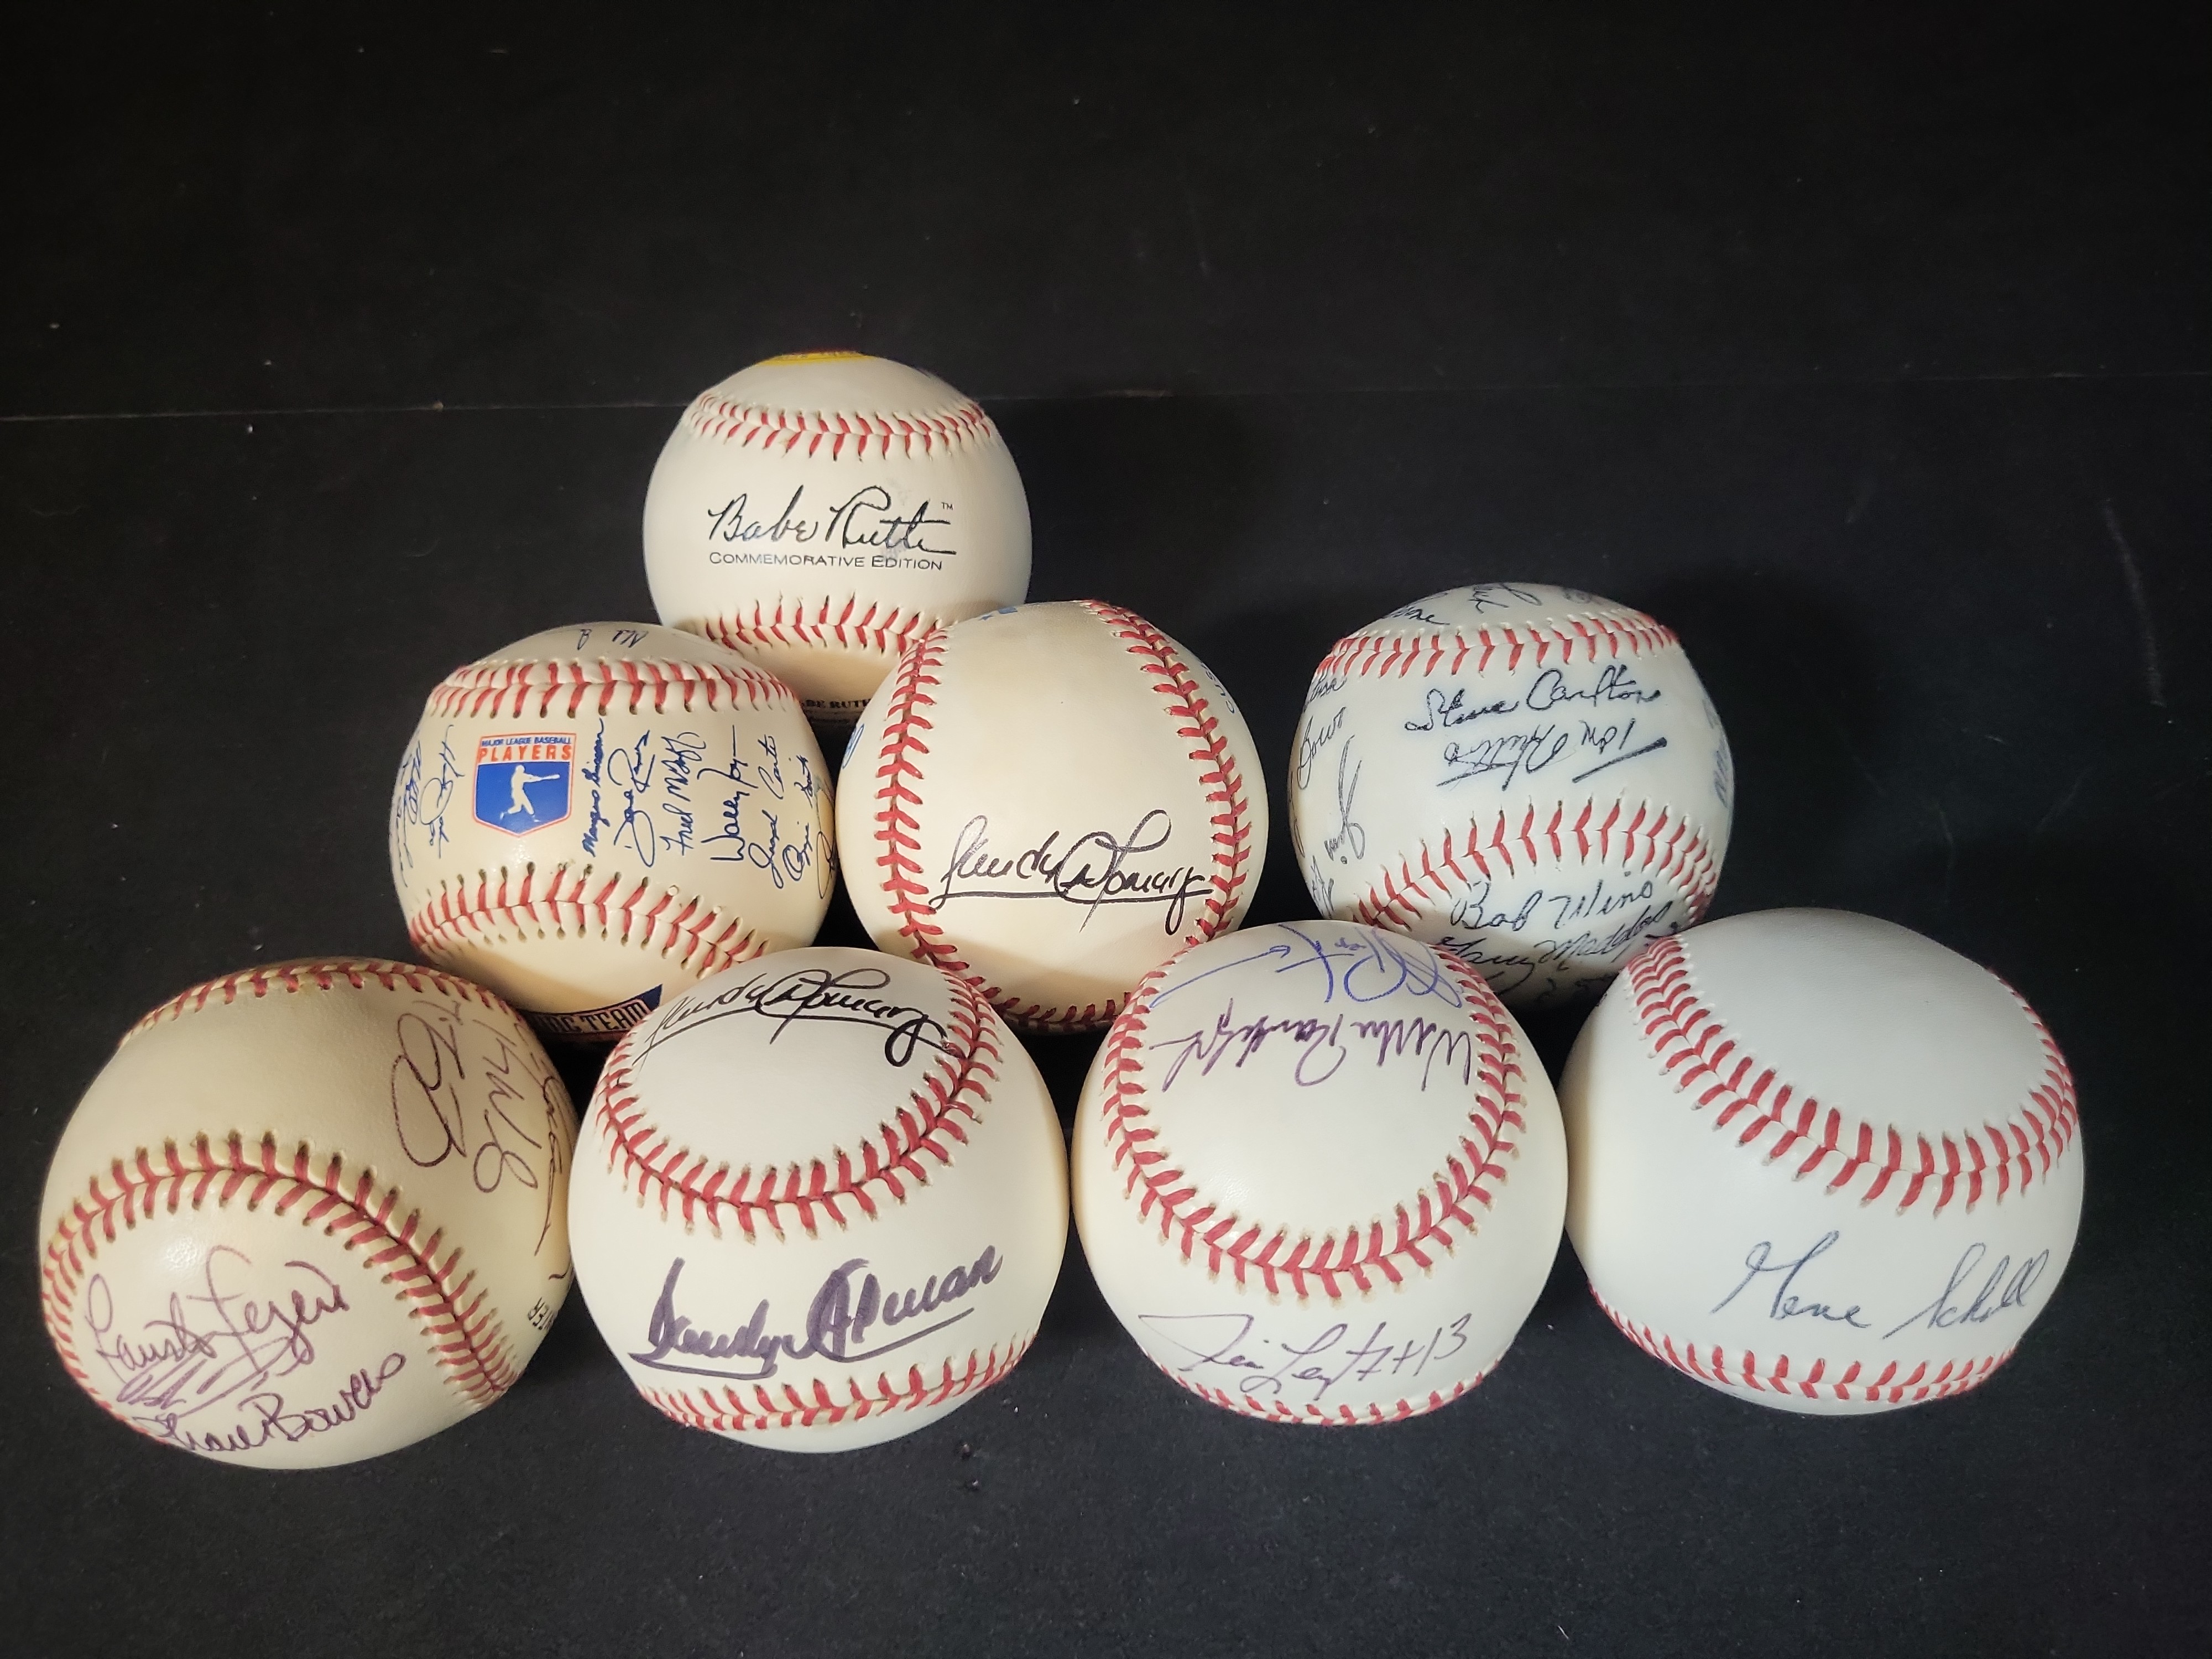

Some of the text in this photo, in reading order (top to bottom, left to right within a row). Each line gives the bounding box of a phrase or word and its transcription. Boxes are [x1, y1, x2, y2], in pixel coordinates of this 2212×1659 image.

[707, 484, 818, 543] Babe
[825, 485, 957, 555] Ruth
[478, 744, 572, 763] PLAYERS
[581, 1002, 646, 1032] TEAM
